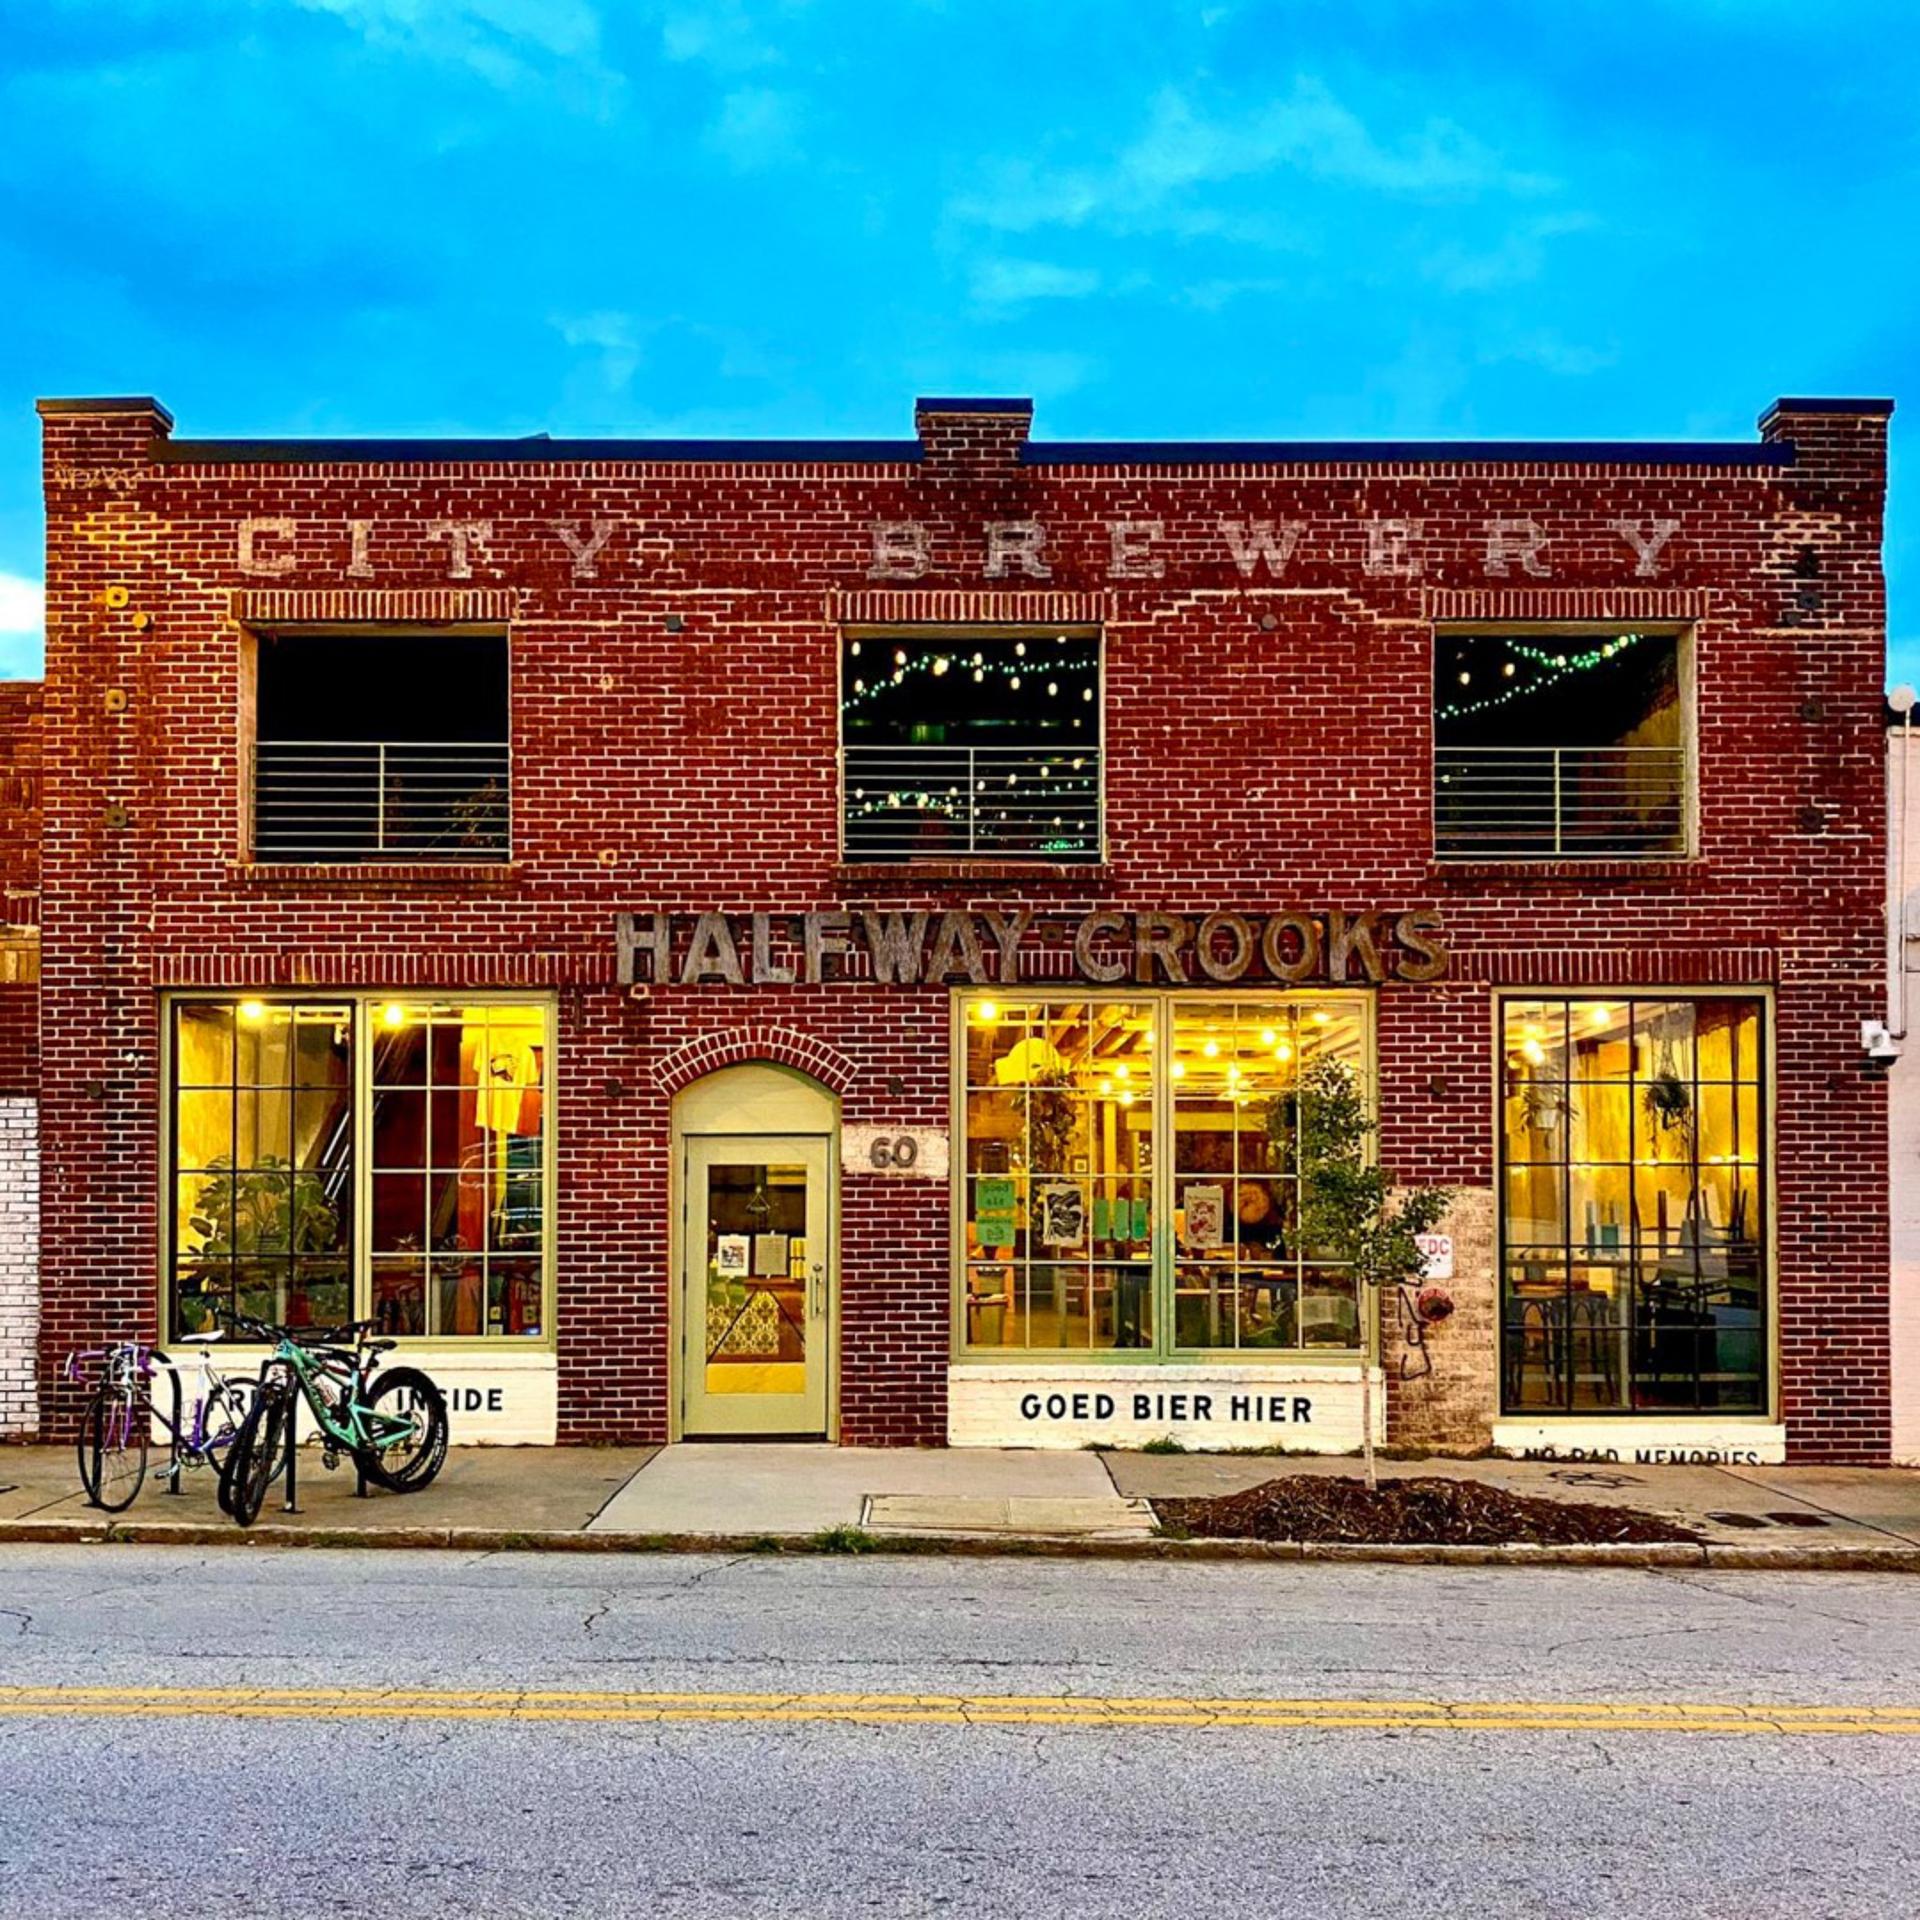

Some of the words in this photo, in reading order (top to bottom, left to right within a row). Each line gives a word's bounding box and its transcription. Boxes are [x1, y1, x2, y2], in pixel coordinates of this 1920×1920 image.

[237, 516, 617, 579] CITY
[866, 519, 1681, 579] BREWERY
[615, 911, 1034, 985] HALFWAY
[1075, 909, 1449, 982] CROOKS
[870, 1135, 918, 1169] 60
[1020, 1393, 1115, 1420] GOED
[1133, 1394, 1213, 1421] BIER
[1231, 1395, 1312, 1423] HIER
